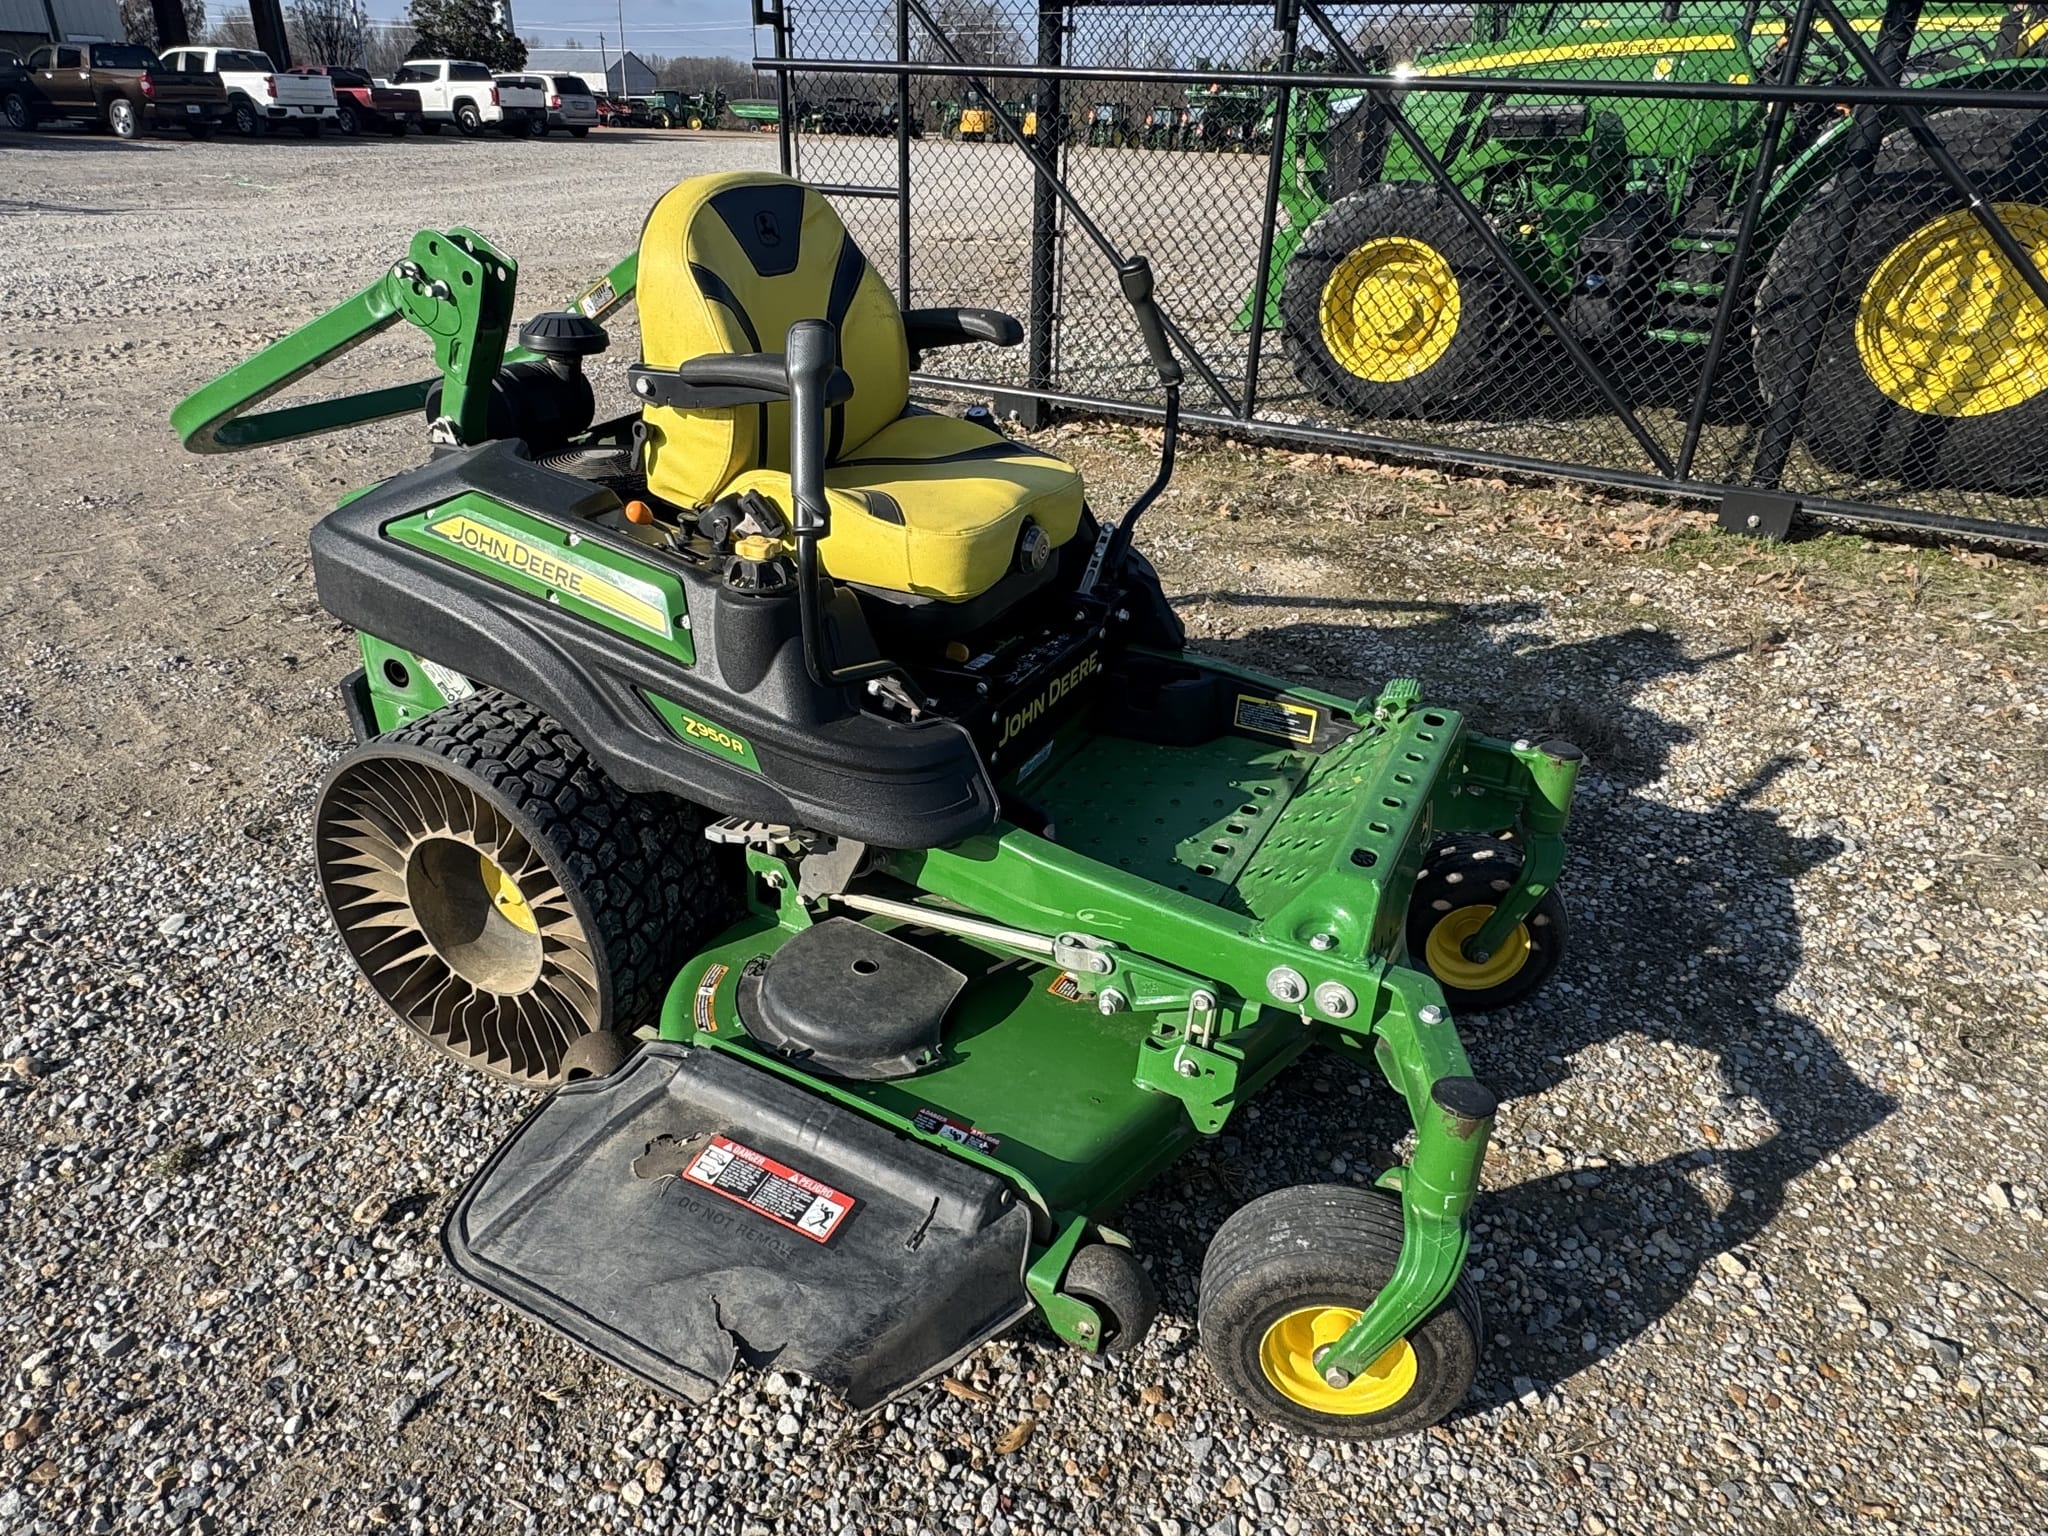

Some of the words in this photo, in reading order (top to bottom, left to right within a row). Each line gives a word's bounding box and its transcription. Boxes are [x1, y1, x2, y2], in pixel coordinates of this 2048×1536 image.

[1579, 46, 1617, 59] JOHN
[1620, 43, 1665, 55] DEERE
[452, 522, 508, 560] JOHN
[512, 544, 584, 593] DEERE
[998, 692, 1046, 748] JOHN
[1048, 650, 1099, 707] DEERE
[682, 715, 745, 756] Z950R
[733, 1144, 766, 1167] DANGER
[799, 1175, 834, 1199] PELIGRO
[702, 1207, 735, 1230] NOT
